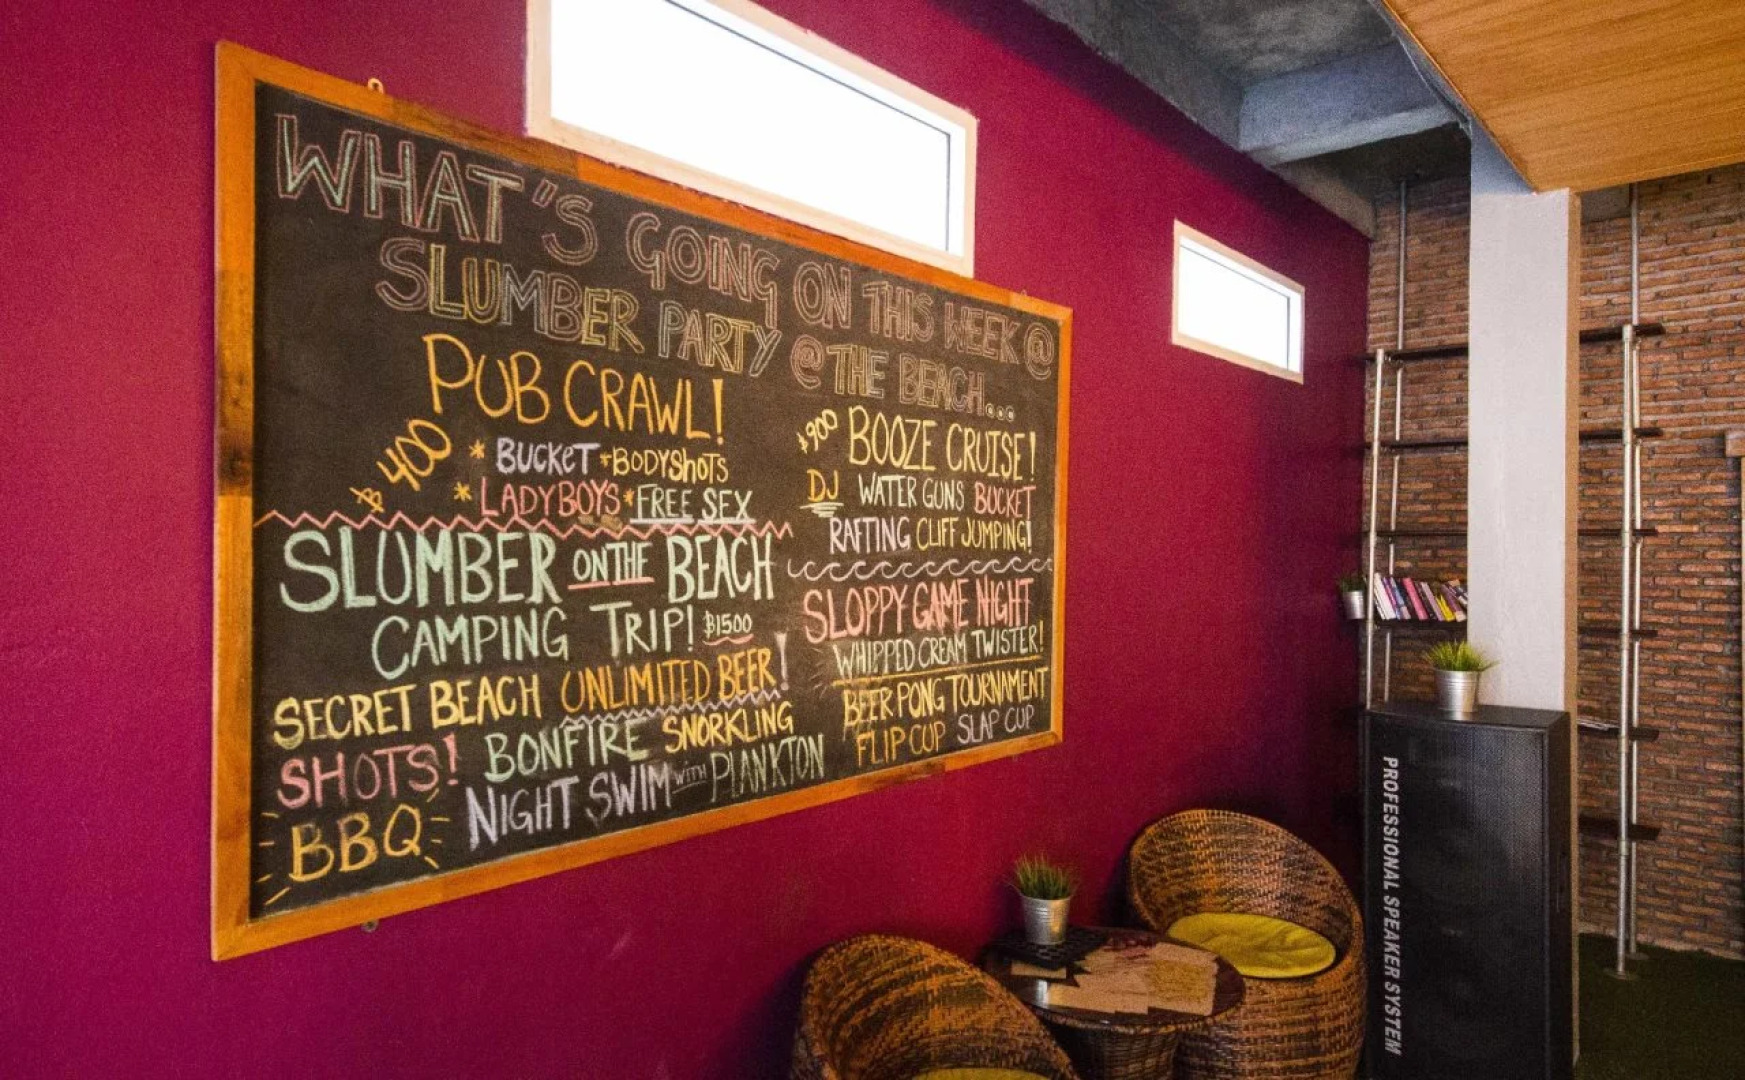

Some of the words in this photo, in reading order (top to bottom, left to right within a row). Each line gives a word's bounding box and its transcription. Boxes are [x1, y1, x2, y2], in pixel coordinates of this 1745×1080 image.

[376, 237, 645, 353] SLUMBER
[658, 300, 783, 377] PARTY
[790, 334, 825, 389] @
[826, 343, 890, 399] THE
[625, 212, 781, 330] GOING
[793, 261, 851, 330] ON
[863, 280, 936, 343] THIS
[944, 301, 1021, 365] WEEK
[1023, 322, 1055, 381] @
[422, 333, 550, 424] PUB
[564, 360, 724, 446] CRAWL!
[376, 419, 451, 491] 400
[849, 405, 938, 471] BOOZE
[946, 423, 1037, 482] CRUISE!
[480, 477, 621, 518] LADYBOYS
[636, 484, 693, 519] FREE
[702, 488, 752, 520] SEX
[806, 469, 840, 502] DJ
[858, 471, 917, 509] WATER
[922, 478, 965, 512] GUNS
[973, 482, 1037, 521] BUCKET
[279, 525, 562, 612] SLUMBER
[573, 546, 608, 582] ON
[605, 540, 653, 582] THE
[667, 532, 775, 603] BEACH
[829, 515, 912, 555] RAFTING
[916, 517, 960, 551] CLIFF
[961, 518, 1033, 554] JUMPING!
[371, 606, 568, 680] CAMPING
[589, 601, 694, 658] TRIP!
[803, 584, 909, 644] SLOPPY
[912, 577, 970, 632] GAME
[975, 574, 1035, 627] NIGHT
[832, 637, 916, 680] WHIPPED
[918, 630, 969, 669] CREAM
[971, 619, 1045, 660] TWISTER!
[273, 684, 417, 750] SECRET
[430, 674, 541, 729] BEACH
[561, 659, 711, 714] UNLIMITED
[842, 685, 895, 728] BEER
[897, 677, 945, 718] PONG
[944, 666, 1049, 714] TOURNAMENT
[855, 726, 907, 767] FLIP
[909, 720, 946, 755] CUP
[957, 708, 1000, 745] SLAP
[1004, 704, 1035, 733] CUP
[277, 731, 458, 808] SHOTS!
[484, 717, 650, 783] BONFIRE
[663, 701, 795, 754] SNORKLING
[289, 803, 421, 882] BBQ
[466, 776, 580, 851] NIGHT
[586, 762, 672, 827] SWIM
[710, 733, 825, 802] PLANKTON
[1382, 756, 1400, 891] PROFESSIONAL
[1383, 896, 1400, 979] SPEAKER
[1384, 981, 1401, 1056] SYSTEM
